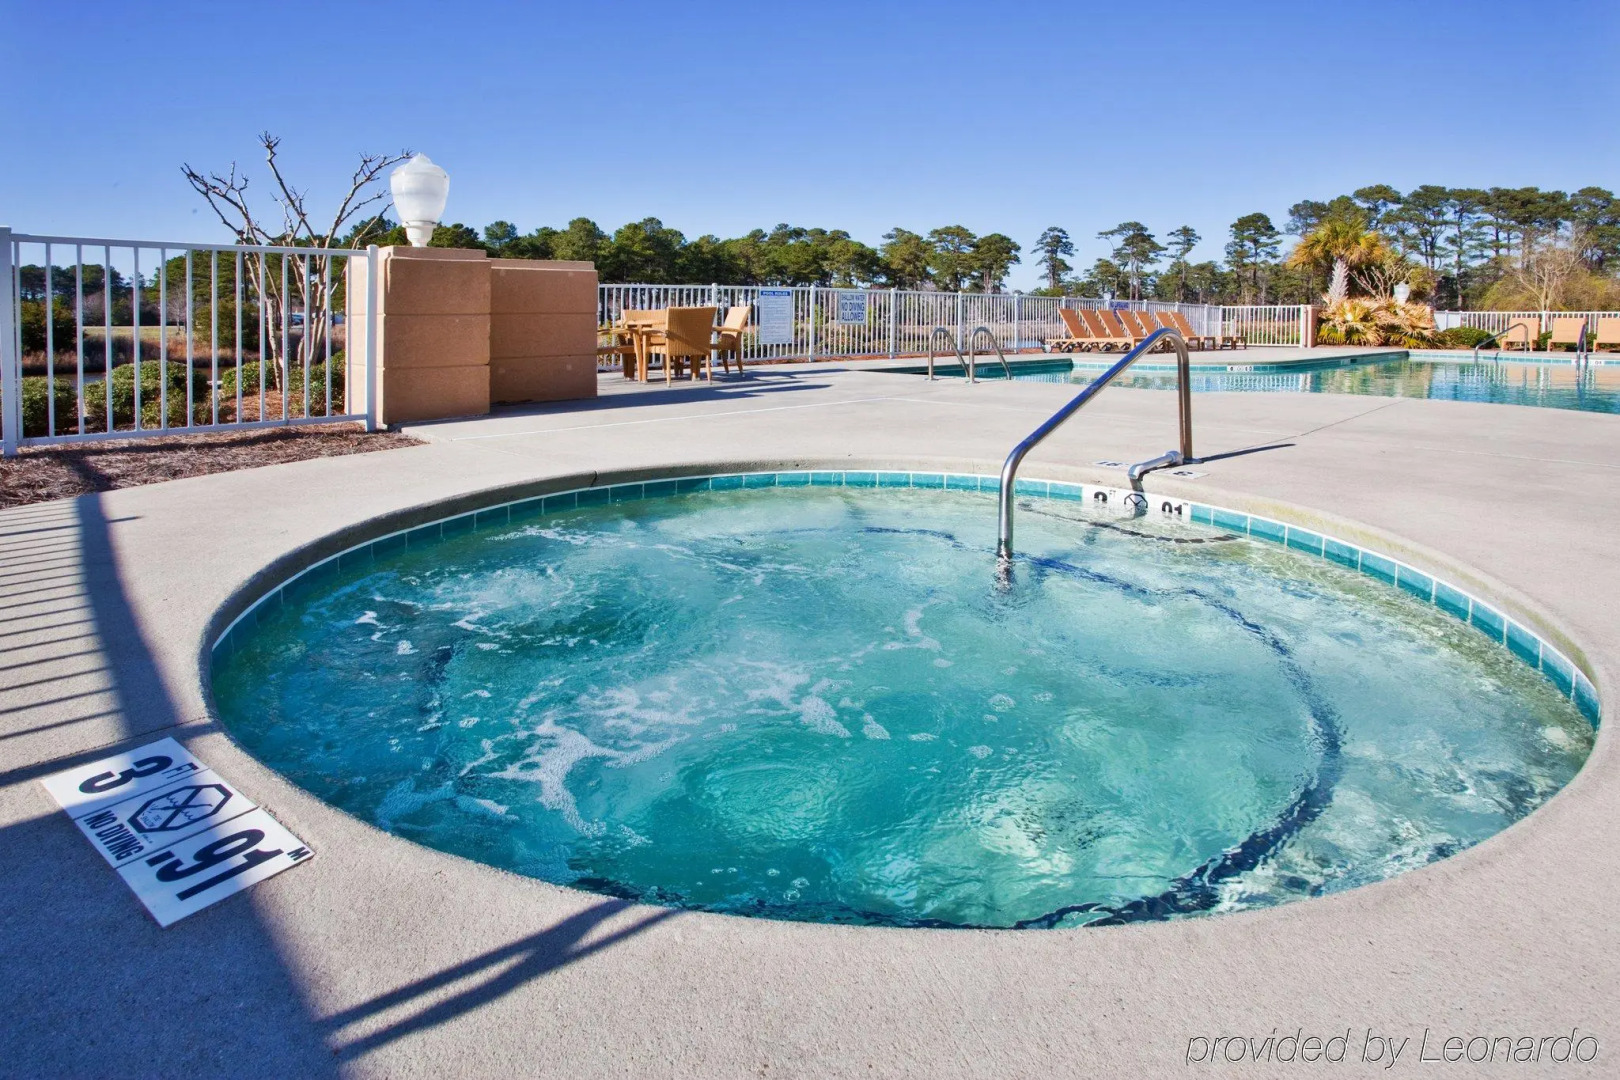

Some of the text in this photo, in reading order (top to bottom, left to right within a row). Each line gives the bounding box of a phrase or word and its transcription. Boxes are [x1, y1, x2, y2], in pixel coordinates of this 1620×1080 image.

[841, 302, 865, 311] NO DIVING
[842, 312, 865, 321] ALLOWED
[79, 755, 199, 794] 3 FT
[86, 810, 145, 861] NO DIVING
[287, 846, 310, 861] M
